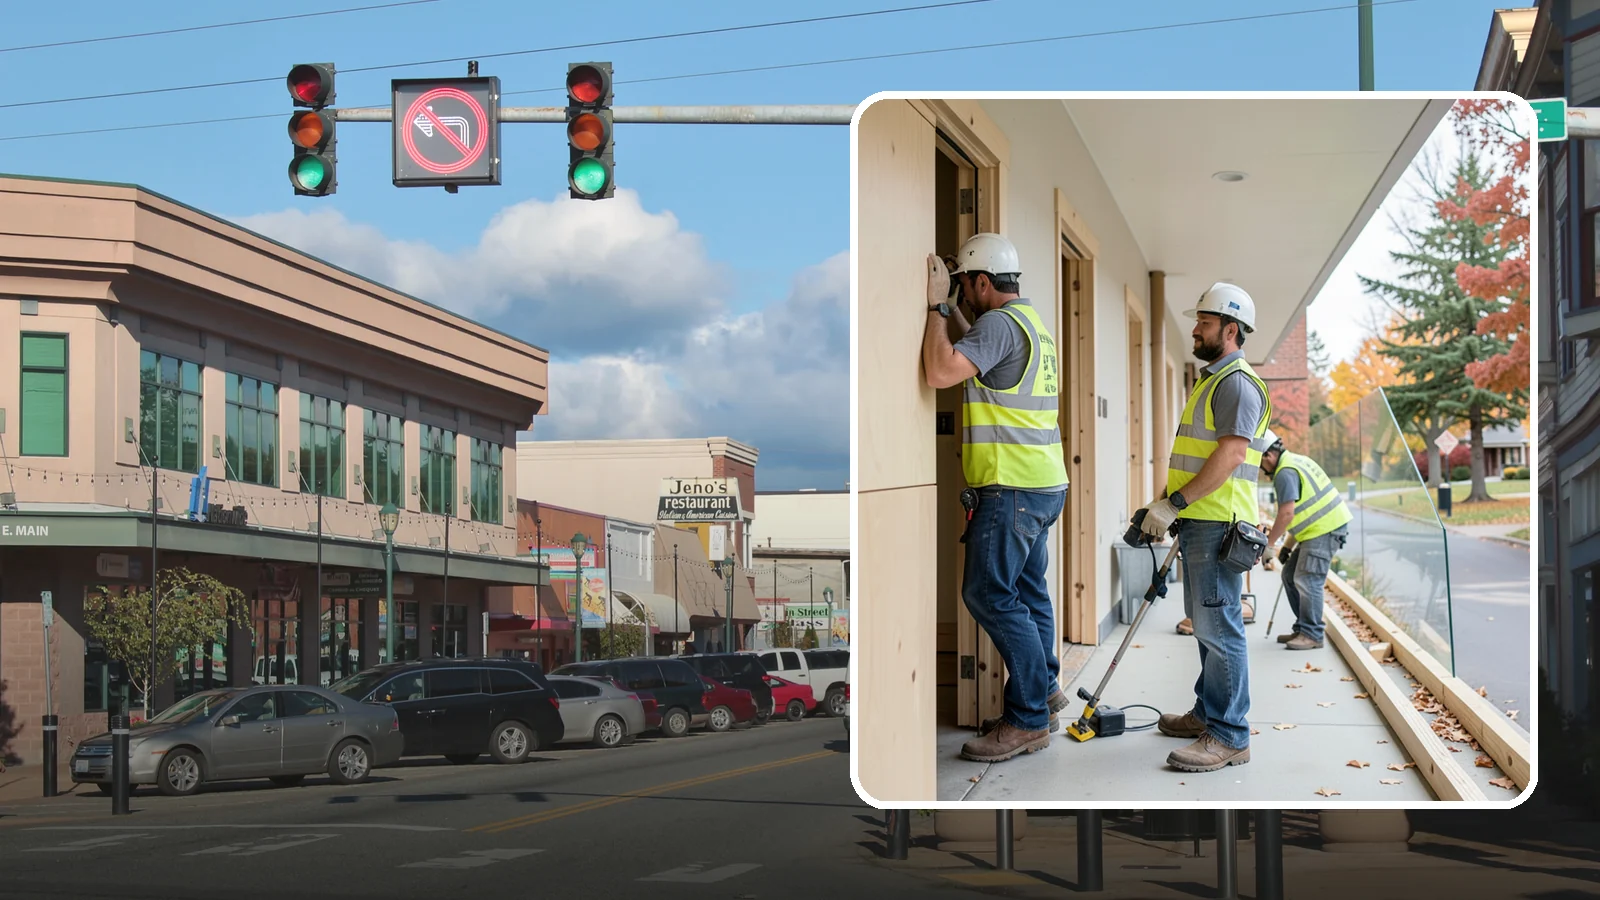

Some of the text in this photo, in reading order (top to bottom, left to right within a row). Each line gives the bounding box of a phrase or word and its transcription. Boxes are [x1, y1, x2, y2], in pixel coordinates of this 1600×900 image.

[669, 480, 728, 495] Jeno's
[665, 496, 731, 509] restaurant
[658, 510, 681, 519] Italian
[686, 510, 714, 519] American
[715, 509, 738, 519] Cuisine
[2, 525, 49, 536] E. MAIN
[797, 608, 828, 617] Street
[790, 619, 824, 627] lass
